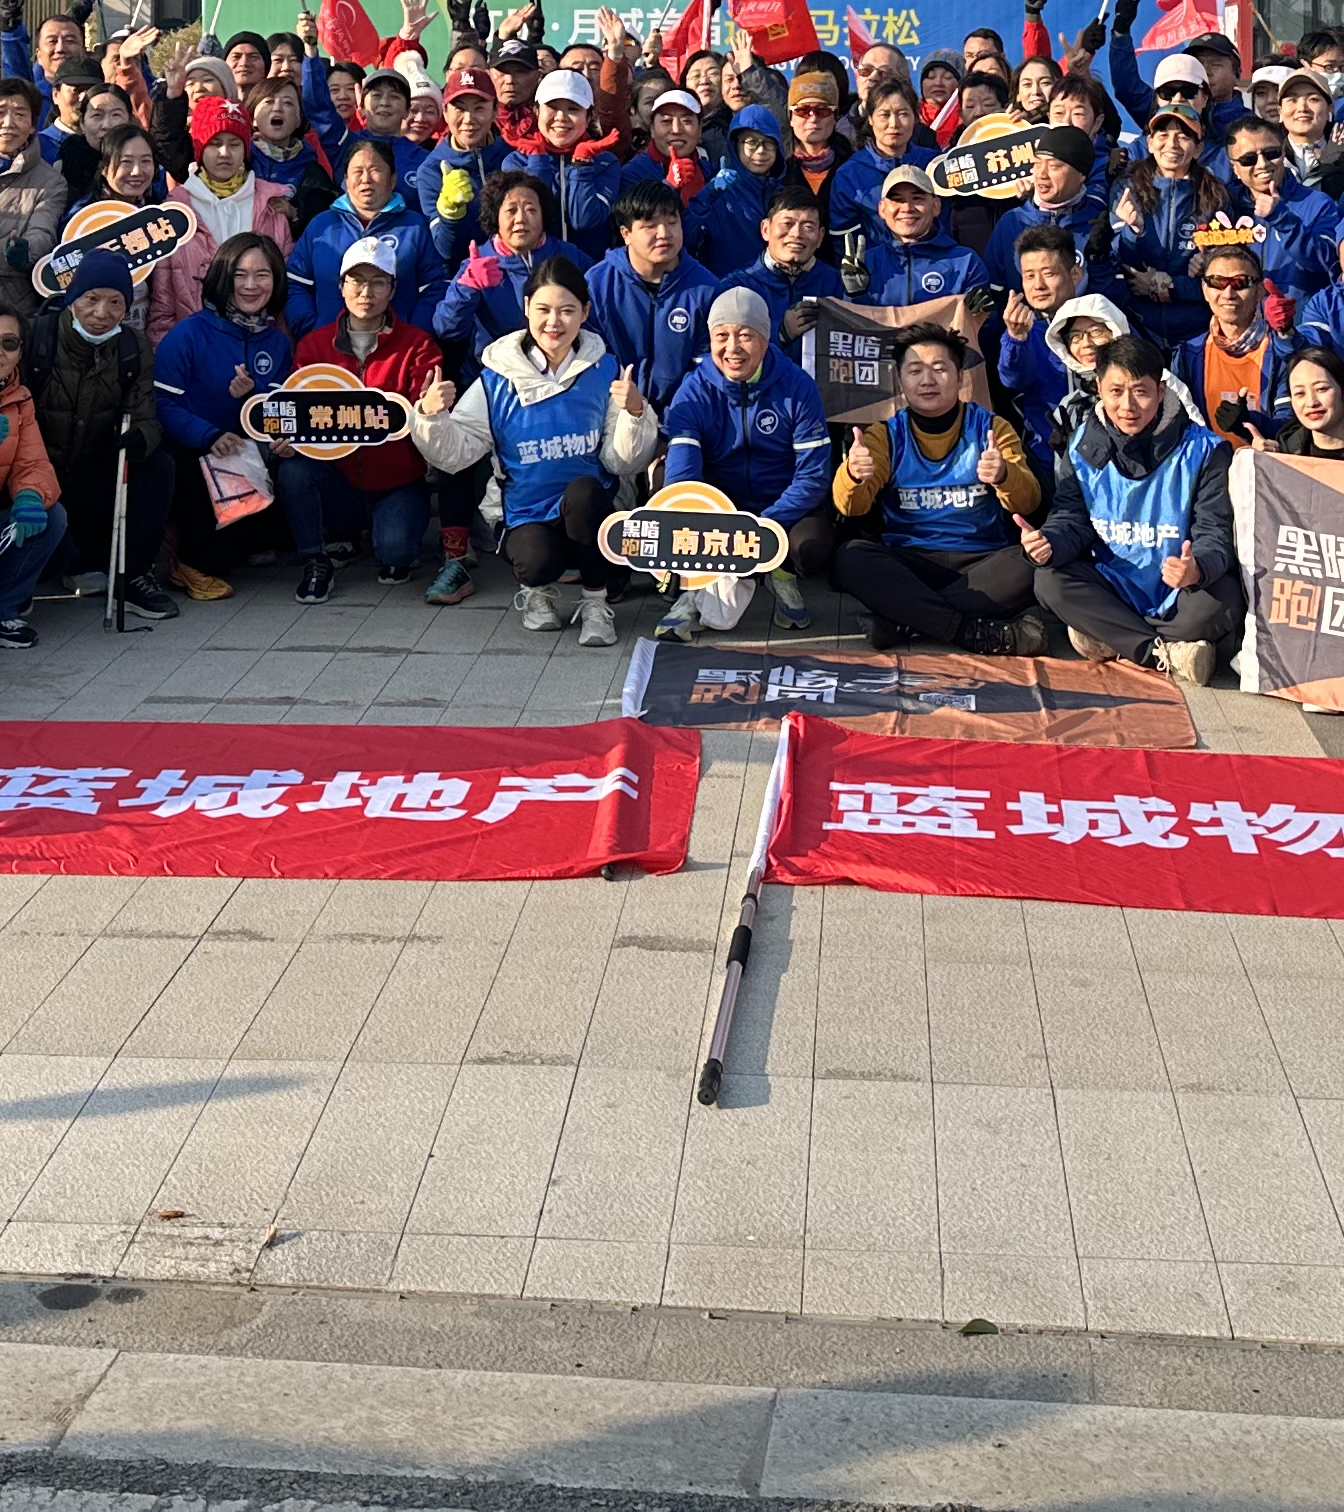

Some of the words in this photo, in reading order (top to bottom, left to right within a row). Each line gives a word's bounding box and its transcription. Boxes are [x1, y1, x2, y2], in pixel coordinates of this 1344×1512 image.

[984, 139, 1041, 174] 苏州
[829, 330, 882, 359] 黑暗
[829, 358, 880, 386] 跑团
[308, 404, 390, 431] 常州站
[517, 429, 600, 465] 蓝城物业
[898, 484, 989, 510] 蓝城地产
[621, 518, 660, 540] 黑暗
[621, 538, 659, 558] 跑团
[672, 527, 761, 560] 南京站
